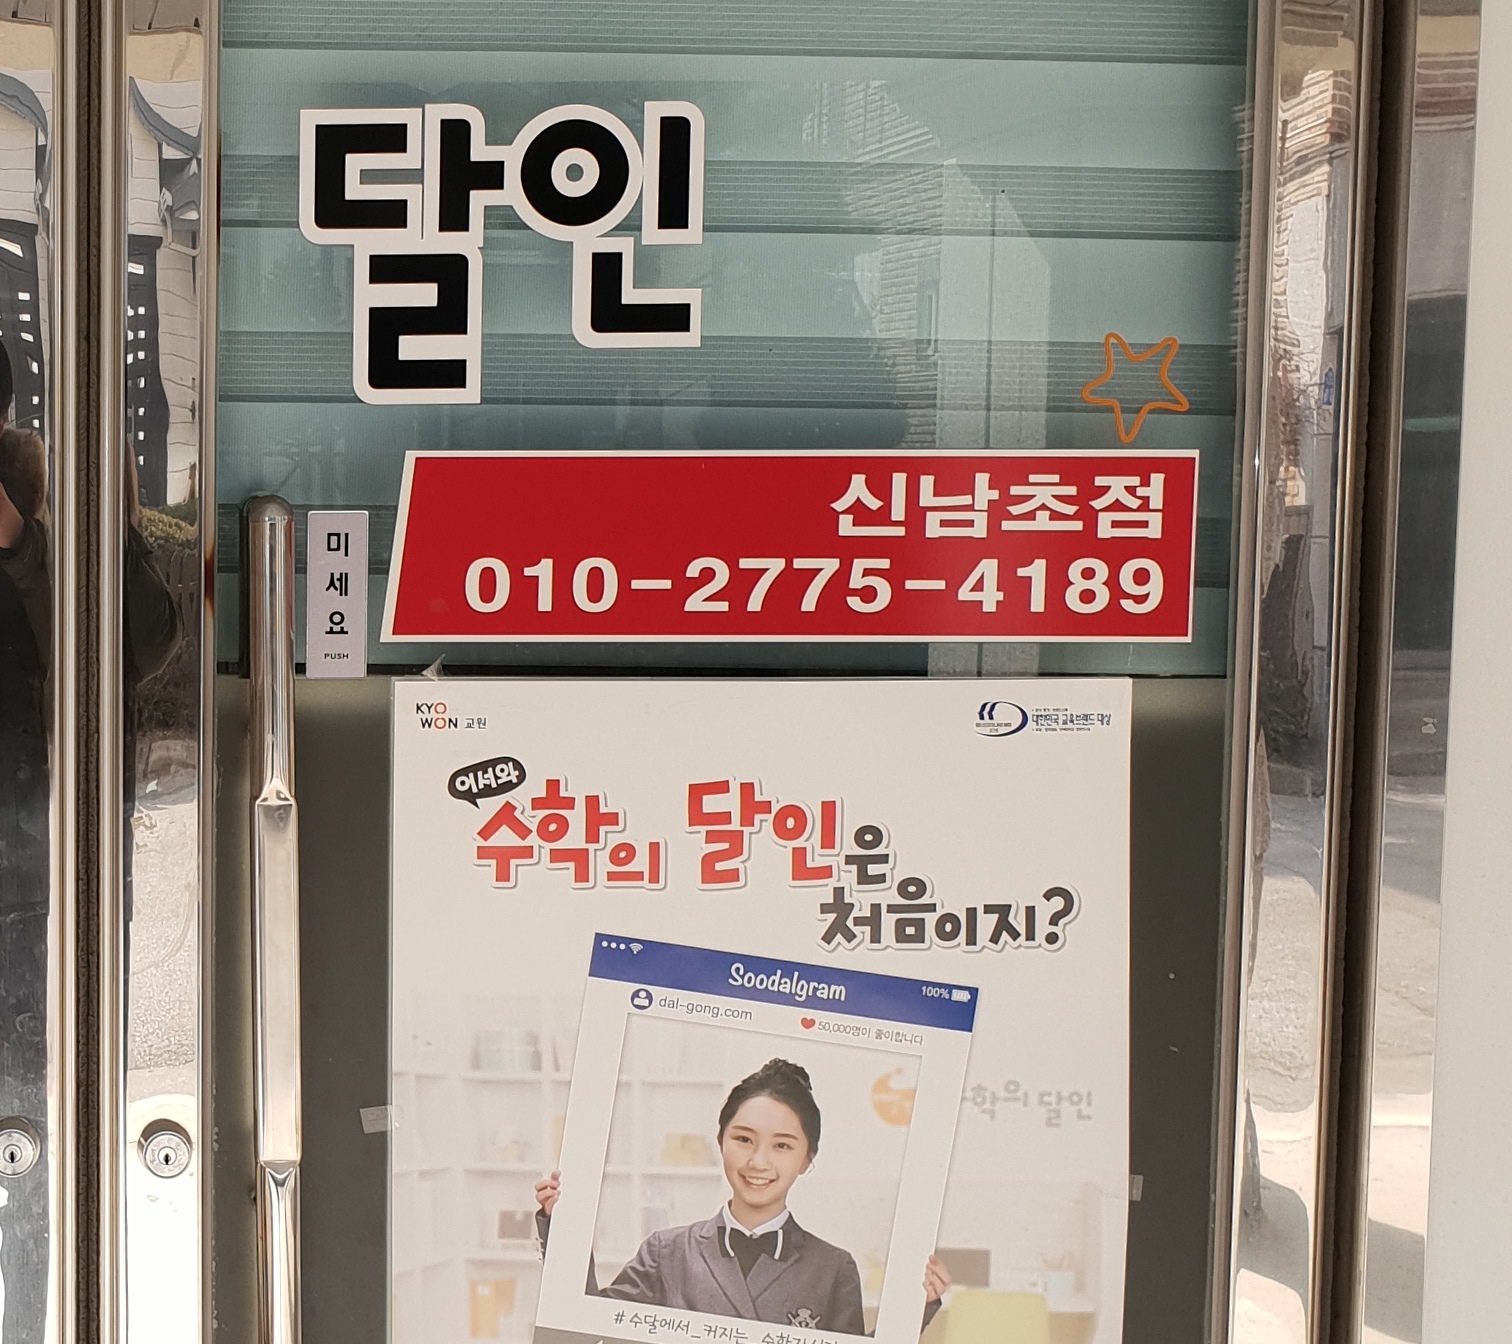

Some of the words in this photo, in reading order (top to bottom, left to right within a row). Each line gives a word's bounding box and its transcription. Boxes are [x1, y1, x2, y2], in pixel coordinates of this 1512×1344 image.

[310, 110, 696, 394] 달인
[830, 471, 1167, 541] 신남초점
[324, 532, 350, 635] 미세요
[462, 555, 1165, 615] 010-2775-4189
[323, 652, 350, 660] PUSH
[415, 701, 448, 715] KYO
[419, 716, 459, 730] WON
[463, 717, 488, 730] 교원
[1031, 713, 1059, 727] 대한민국
[1096, 712, 1113, 726] 대상
[475, 777, 662, 885] 수학의
[686, 778, 891, 886] 달인은
[818, 875, 1076, 947] 처음이지?
[727, 962, 848, 1003] Soodalgram
[920, 984, 950, 1000] 100%
[658, 993, 754, 1022] dal-gong.com
[816, 1020, 872, 1040] 50,000명이
[874, 1026, 925, 1047] 좋아합니다
[962, 1079, 1029, 1121] 학의
[1037, 1089, 1094, 1129] 달인
